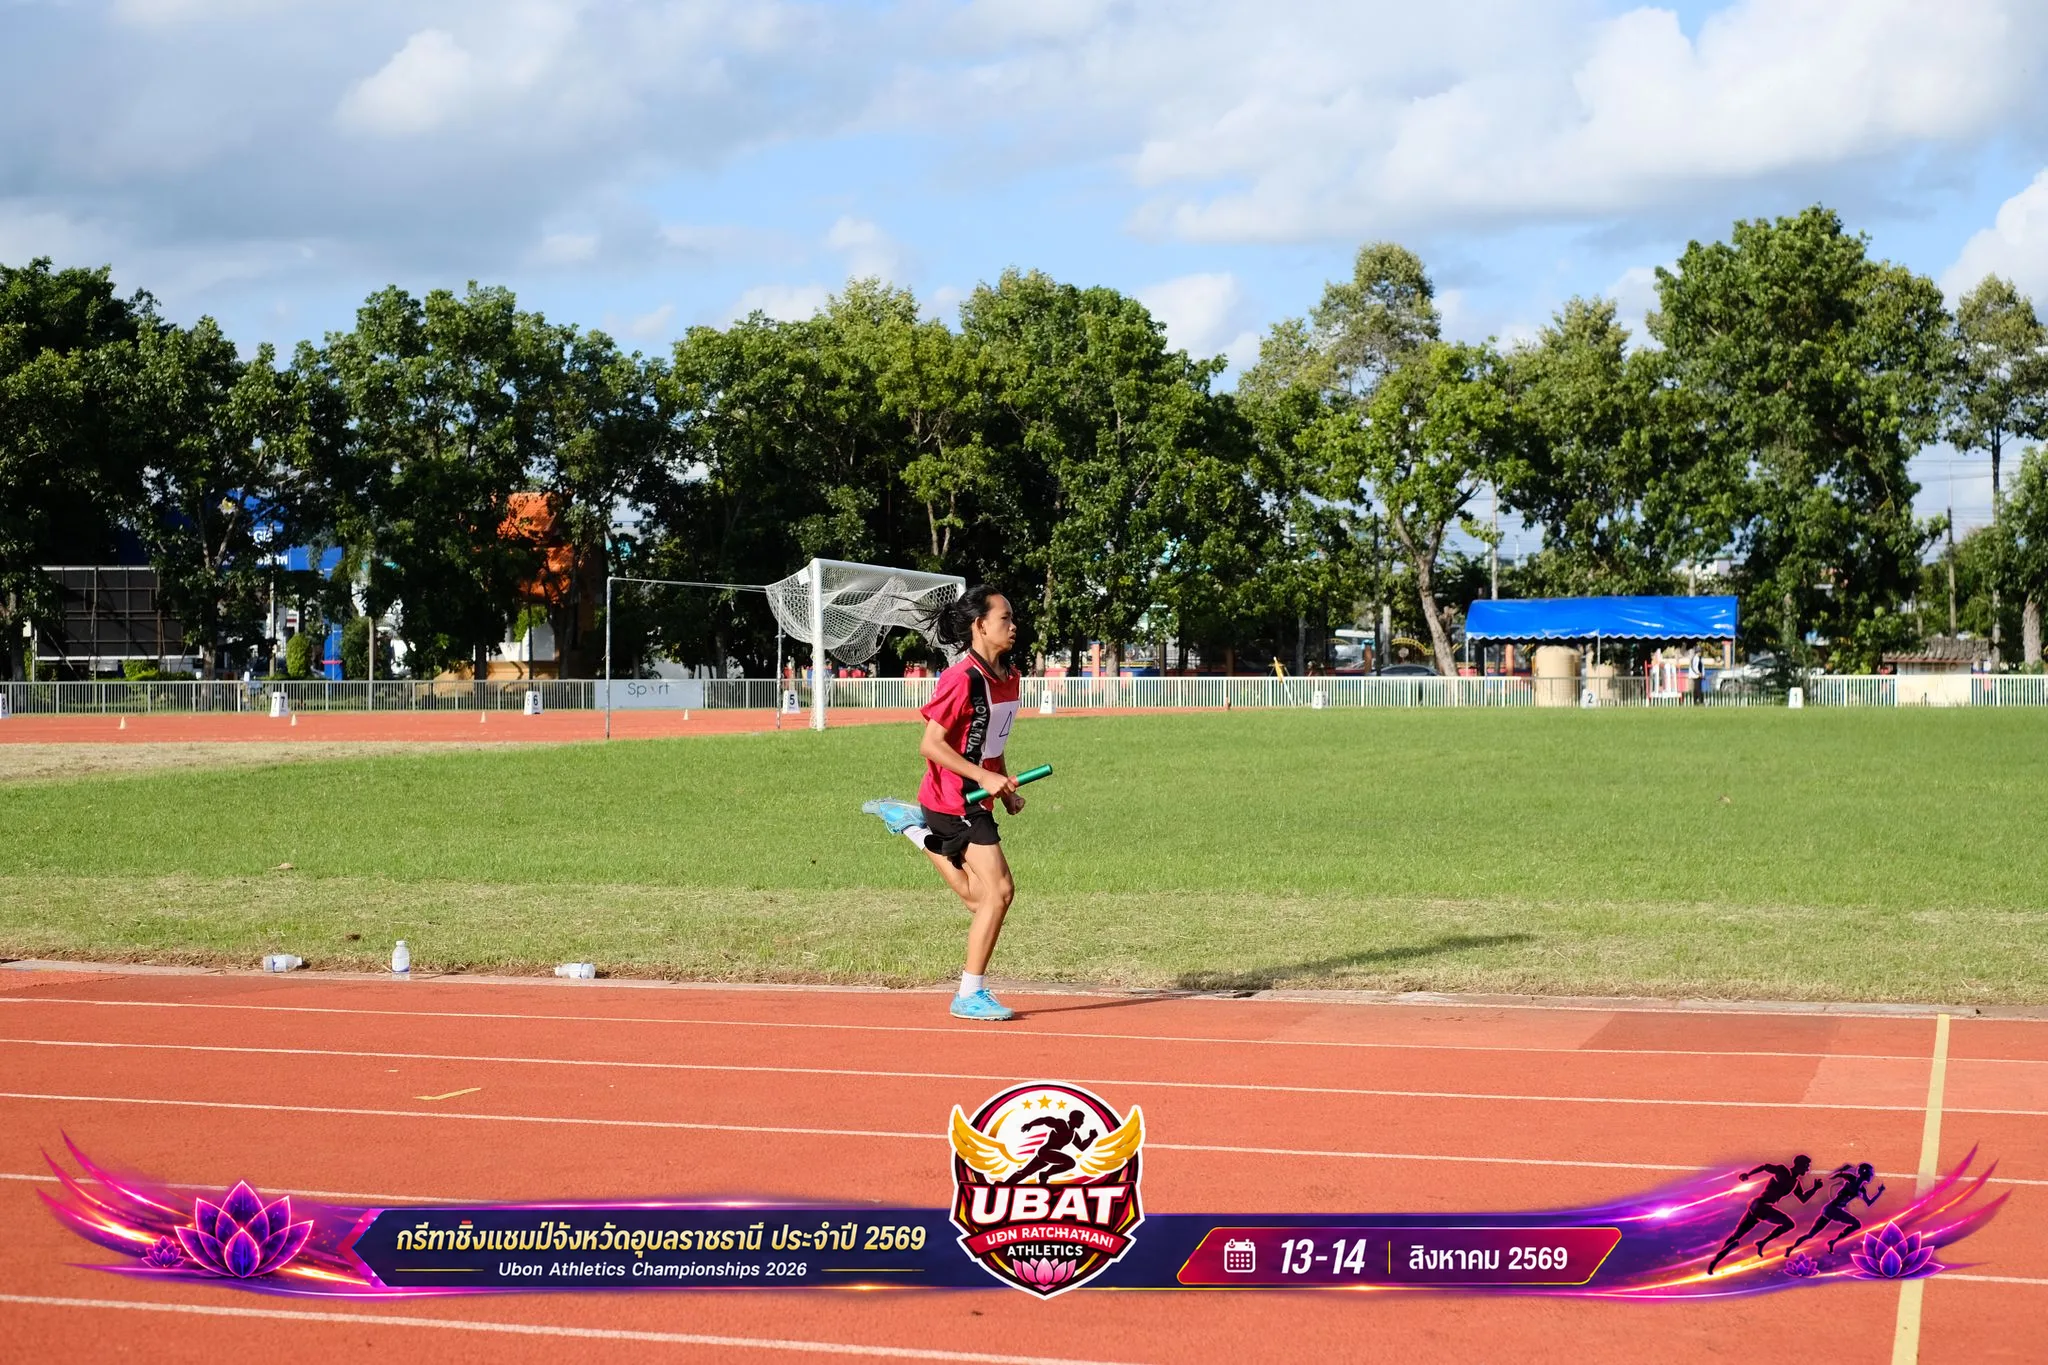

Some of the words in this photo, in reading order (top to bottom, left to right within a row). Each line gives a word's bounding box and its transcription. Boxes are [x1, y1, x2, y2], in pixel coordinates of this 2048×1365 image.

[1, 698, 7, 710] 8
[280, 695, 286, 708] 7
[533, 694, 539, 706] 6
[789, 694, 795, 705] 5
[1587, 693, 1593, 704] 2
